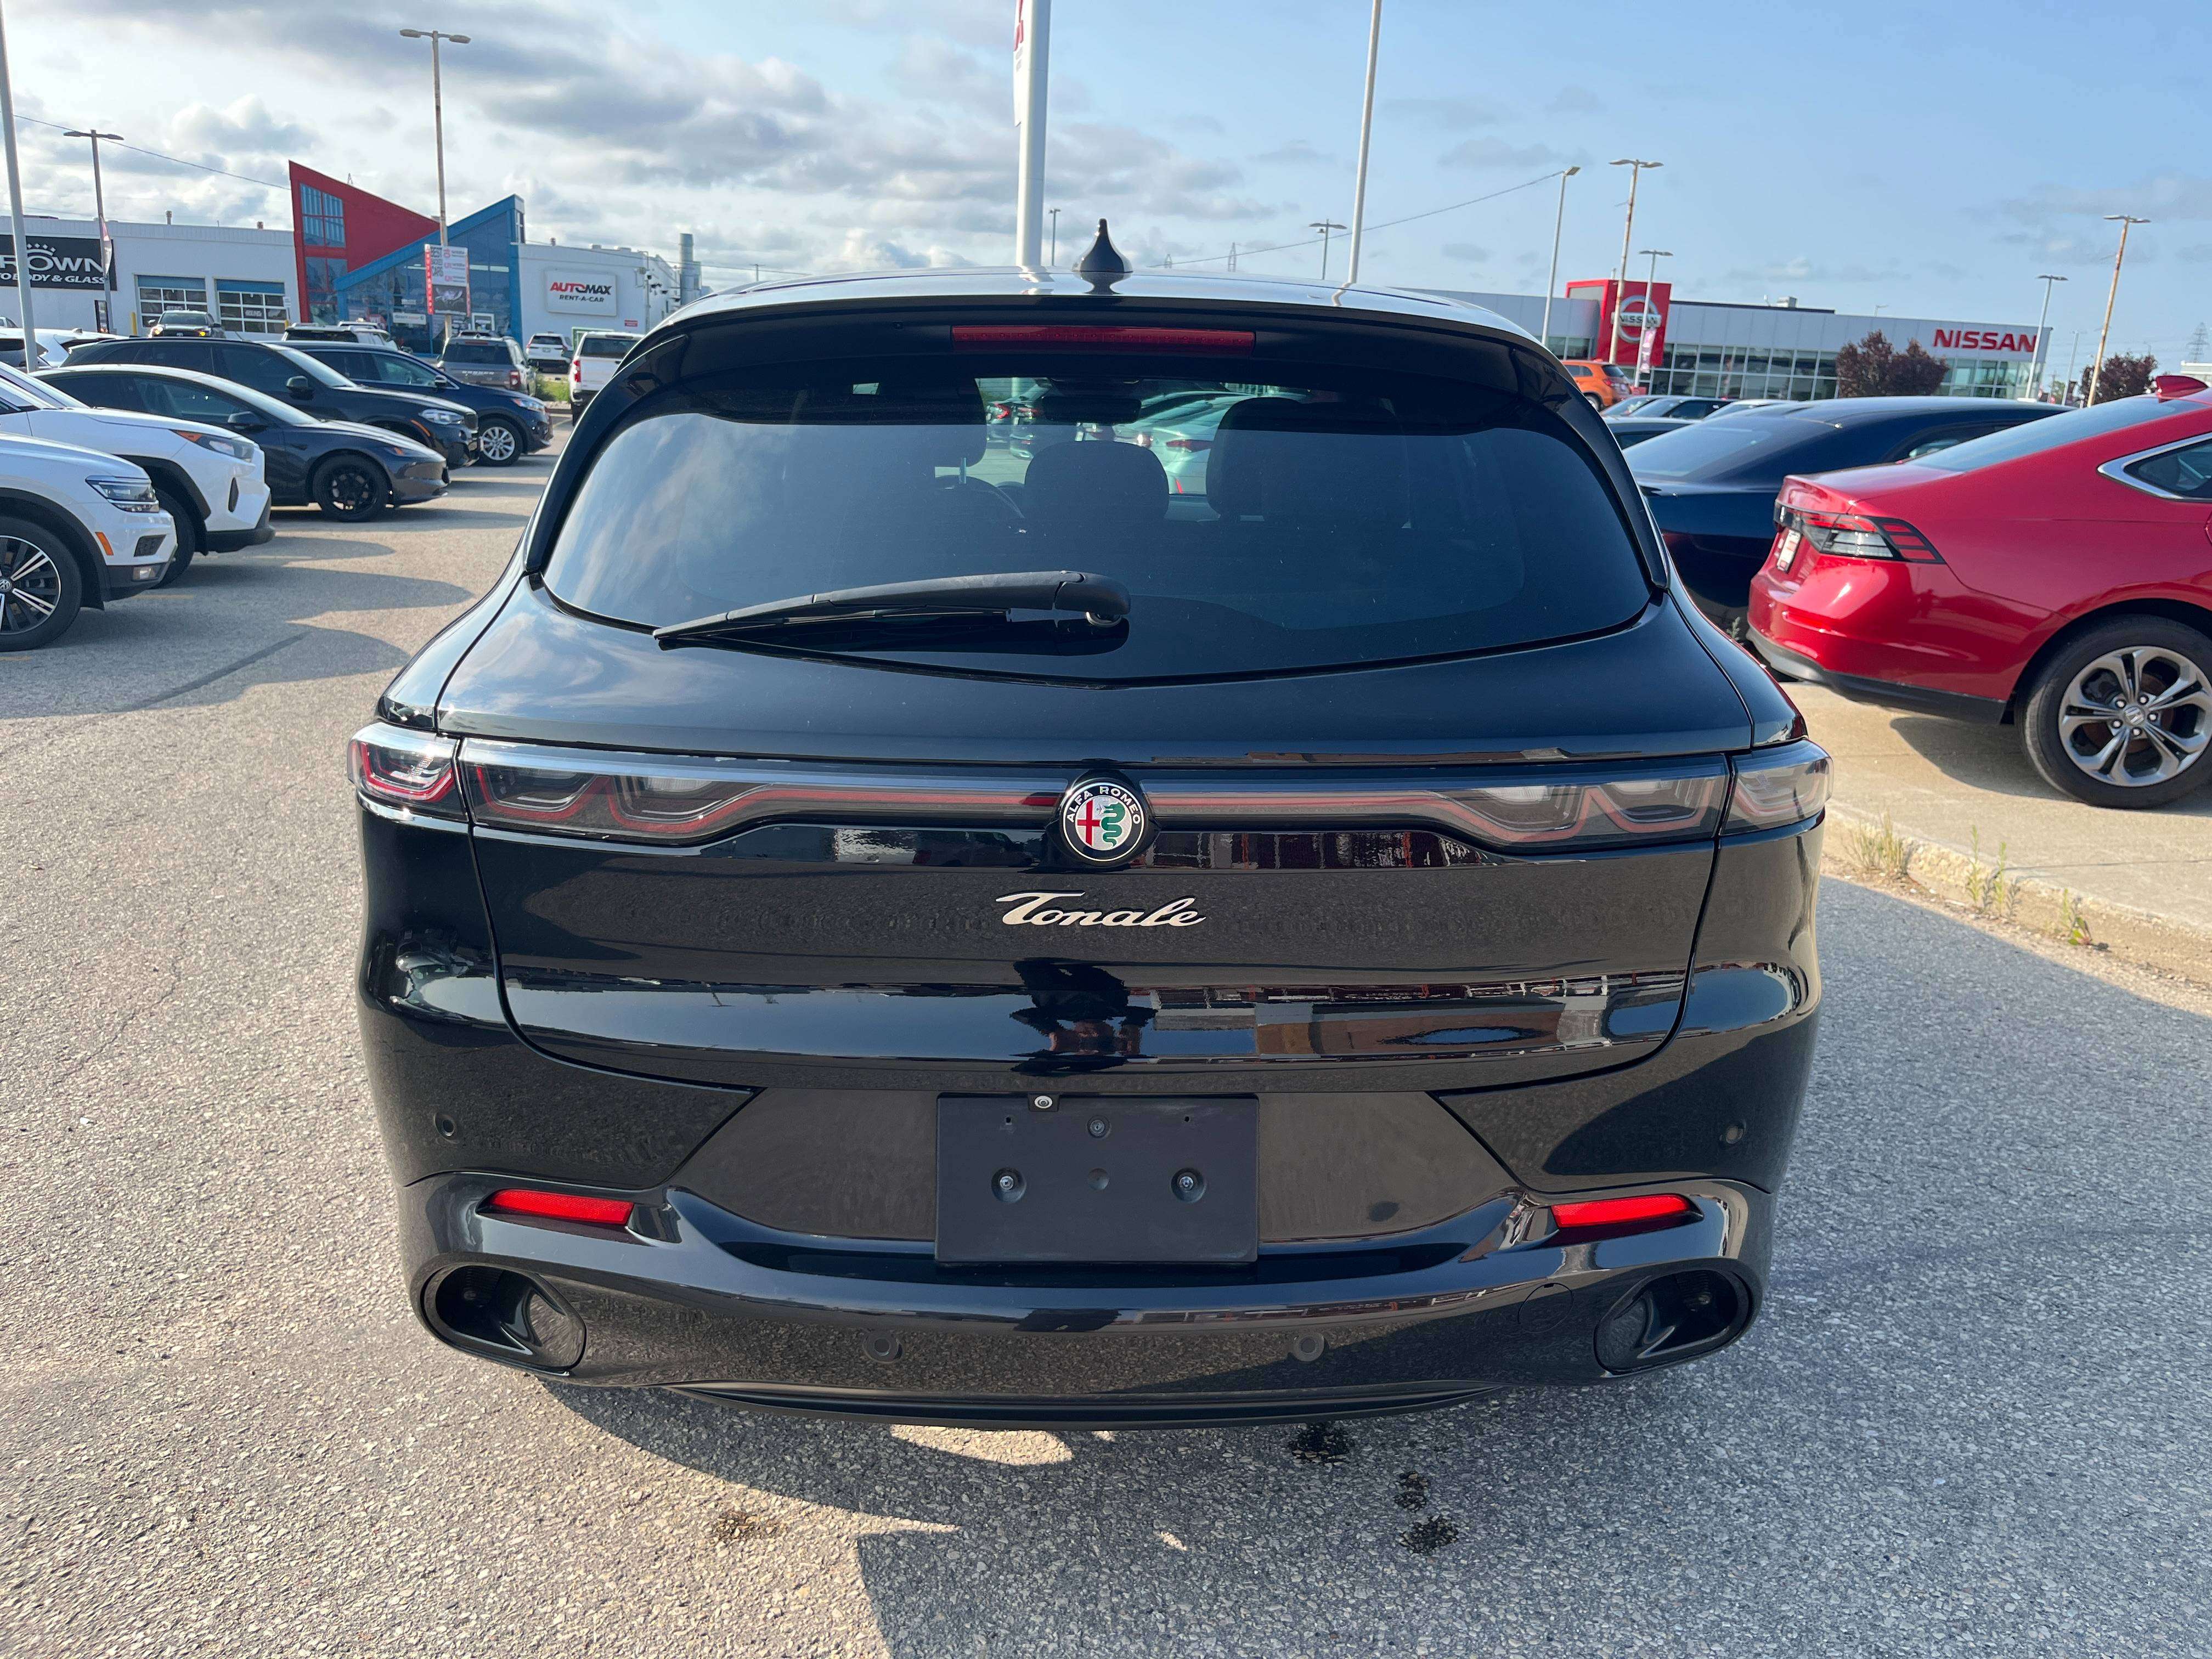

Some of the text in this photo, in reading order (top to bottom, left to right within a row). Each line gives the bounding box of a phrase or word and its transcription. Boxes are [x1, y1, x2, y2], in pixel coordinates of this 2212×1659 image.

[550, 281, 612, 295] AUTOMAX
[1933, 329, 2037, 352] NISSAN
[1066, 786, 1141, 824] ALFA ROMEO
[995, 891, 1206, 927] Tonale
